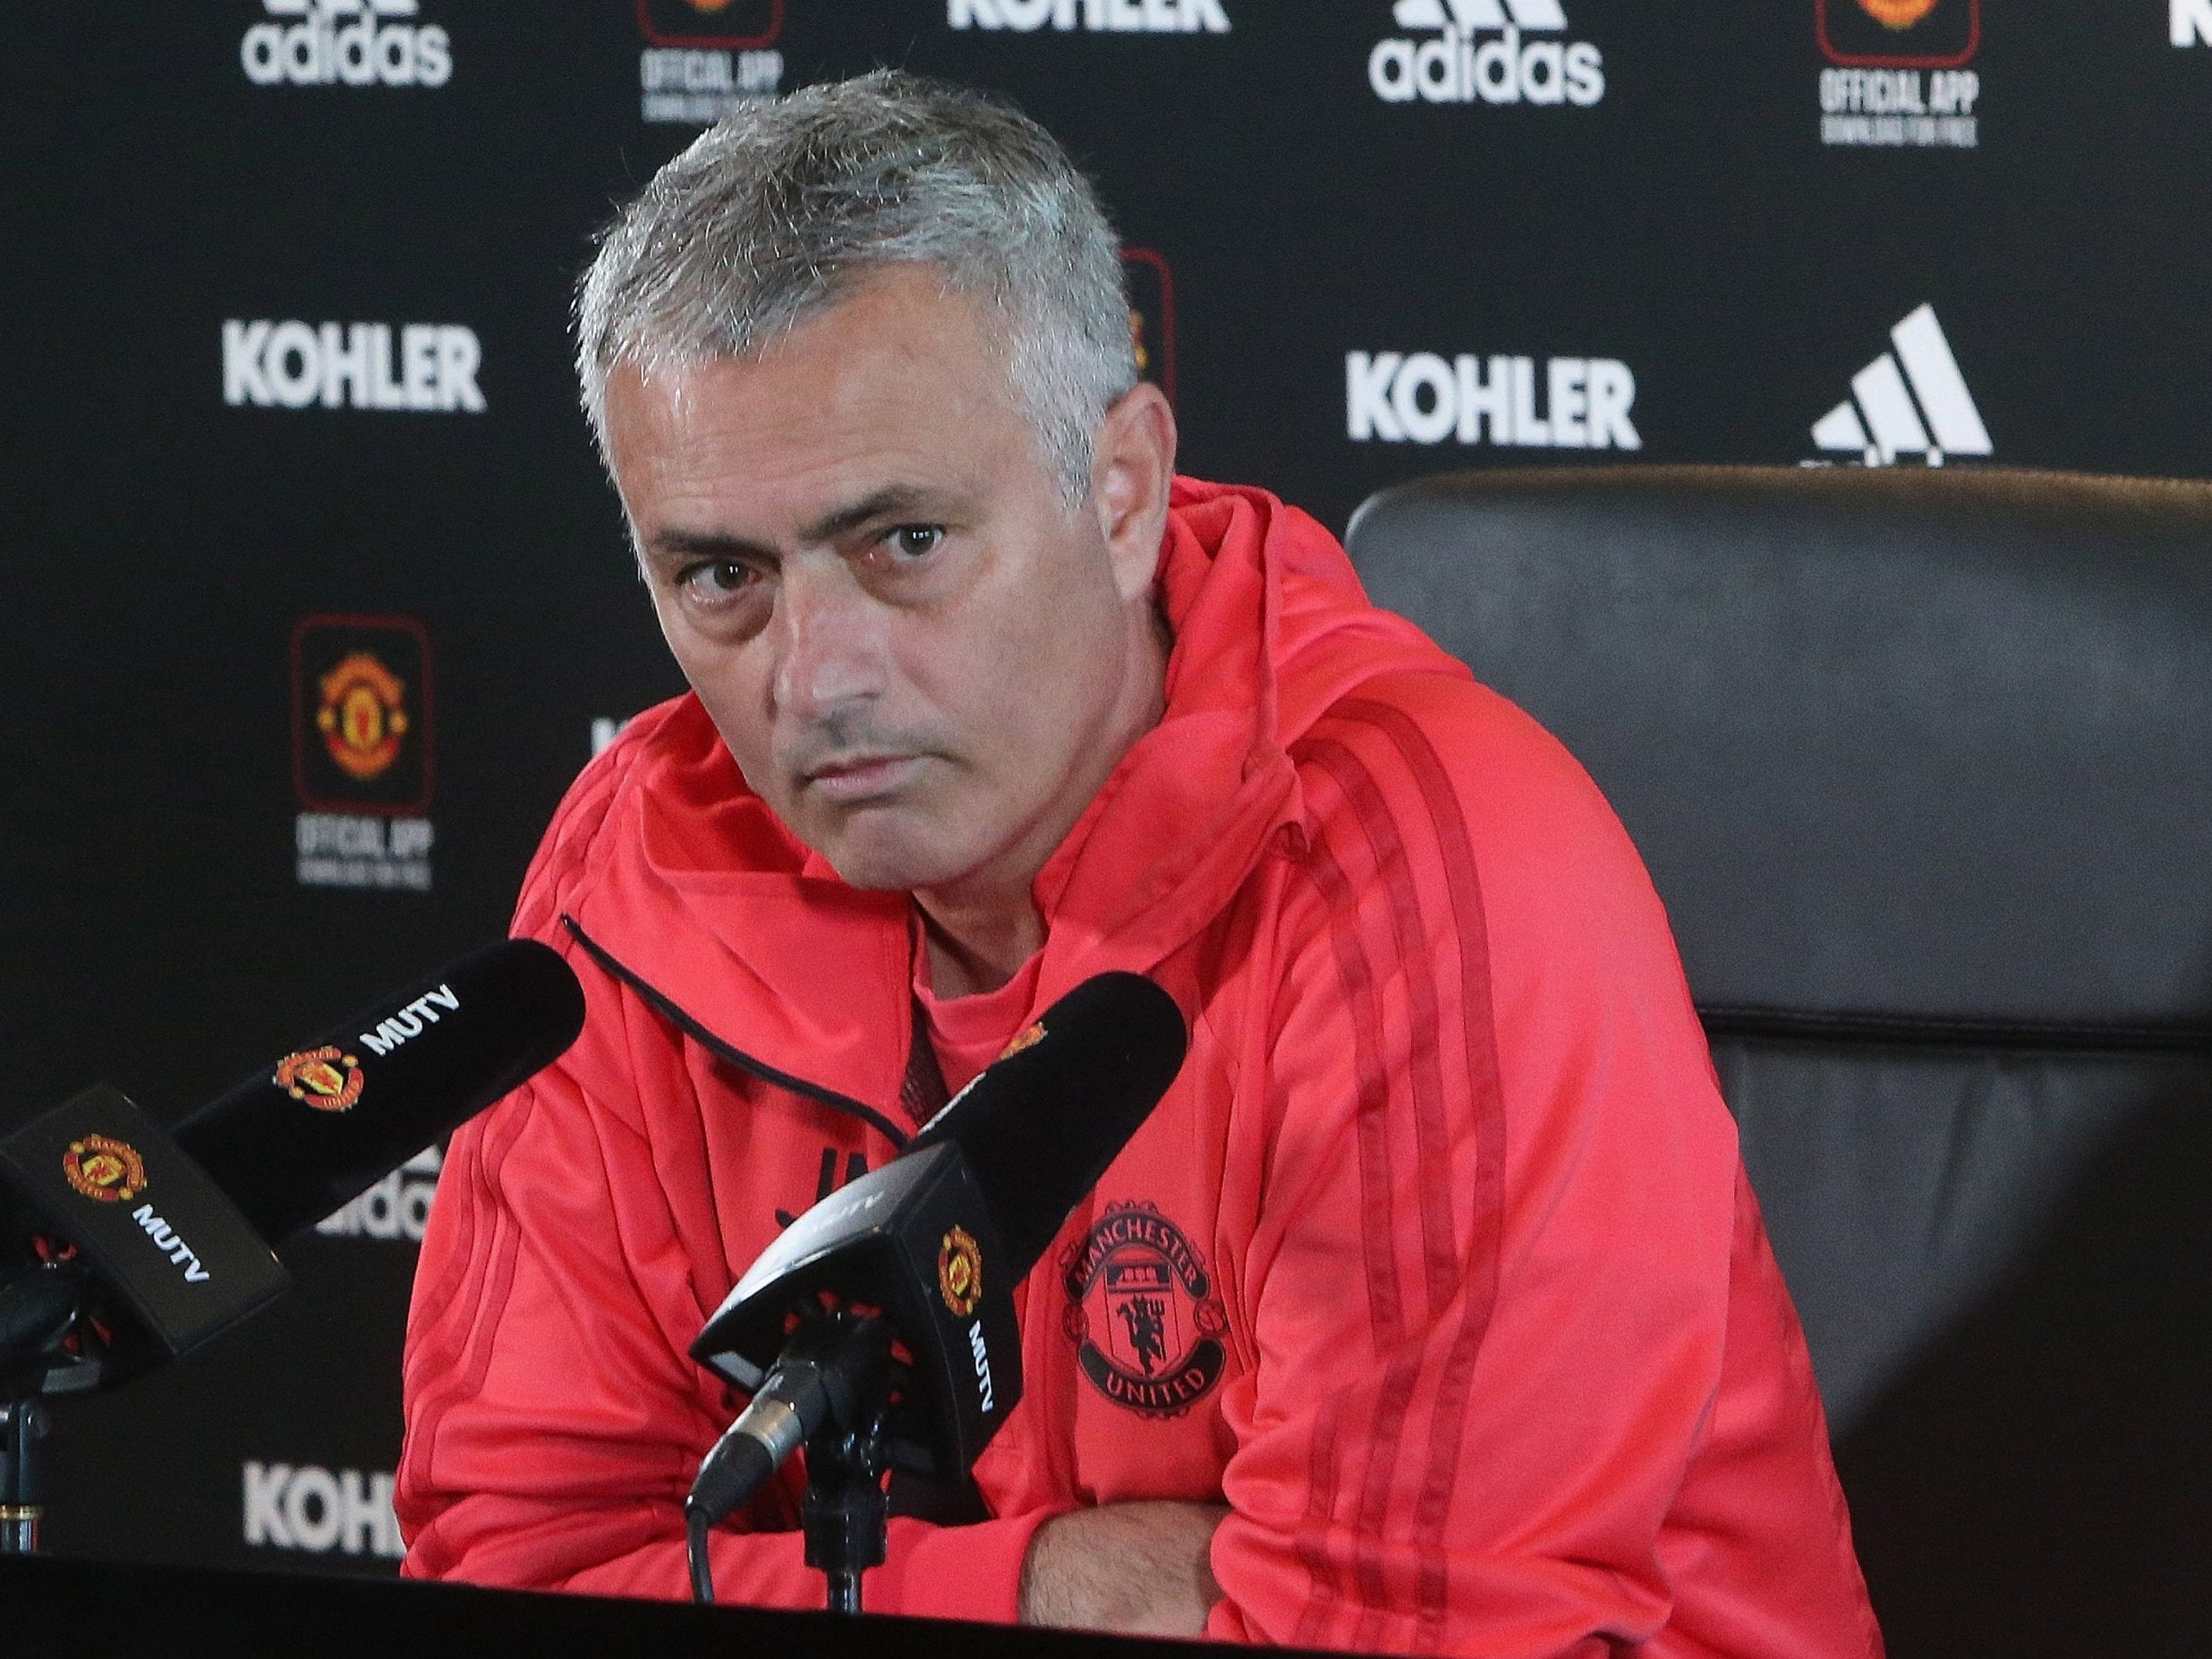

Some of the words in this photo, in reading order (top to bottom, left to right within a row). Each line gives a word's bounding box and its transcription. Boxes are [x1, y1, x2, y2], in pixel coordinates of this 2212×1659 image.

[241, 13, 453, 87] adidas
[1368, 21, 1605, 106] adidas
[222, 319, 487, 413] KOHLER
[1346, 350, 1642, 450] KOHLER
[360, 984, 460, 1056] MUTV
[132, 1204, 210, 1282] MUTV
[1075, 1218, 1198, 1289] MANCHESTER
[969, 1319, 994, 1413] MUTV
[1105, 1367, 1206, 1406] UNITED
